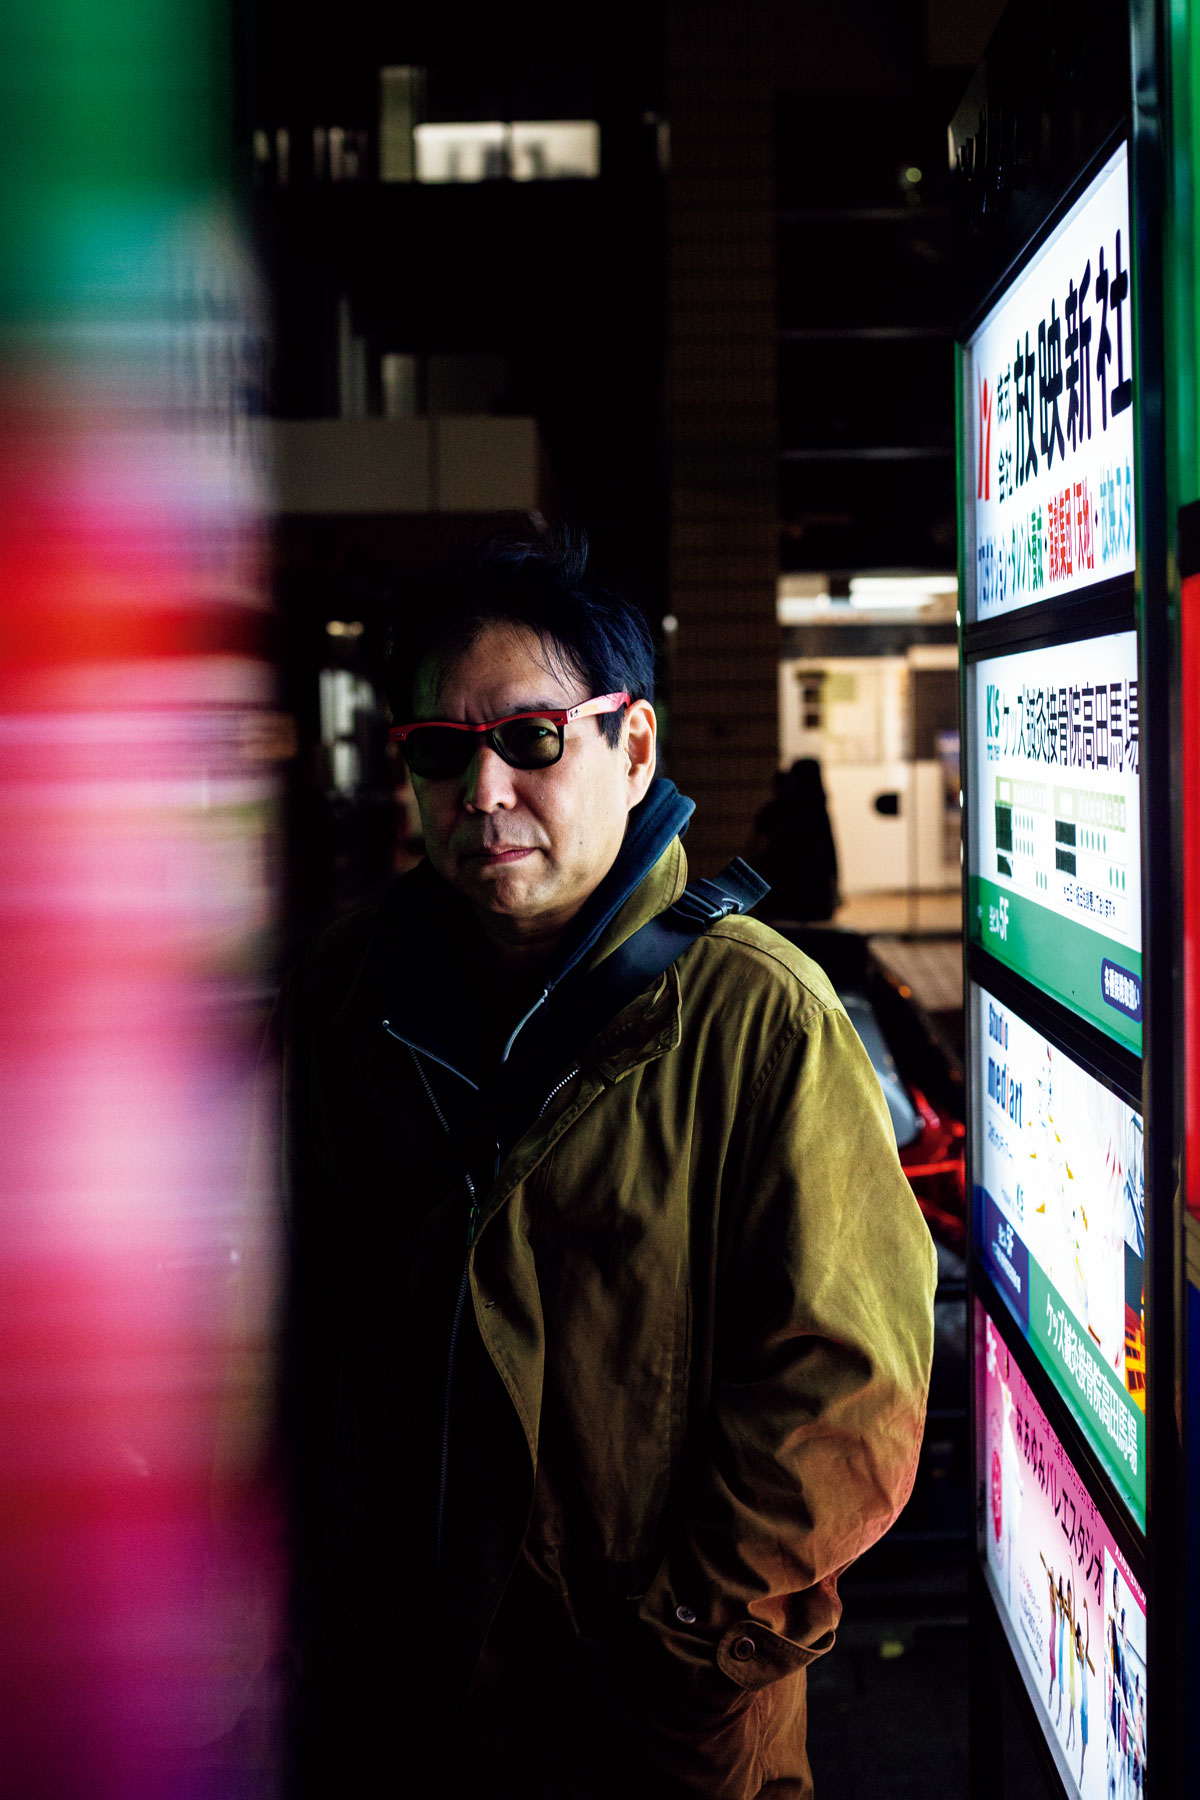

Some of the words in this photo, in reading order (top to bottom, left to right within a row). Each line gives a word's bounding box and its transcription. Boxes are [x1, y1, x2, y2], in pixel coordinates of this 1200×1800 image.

[1014, 229, 1133, 489] 放映新社
[987, 1057, 1023, 1129] mediart
